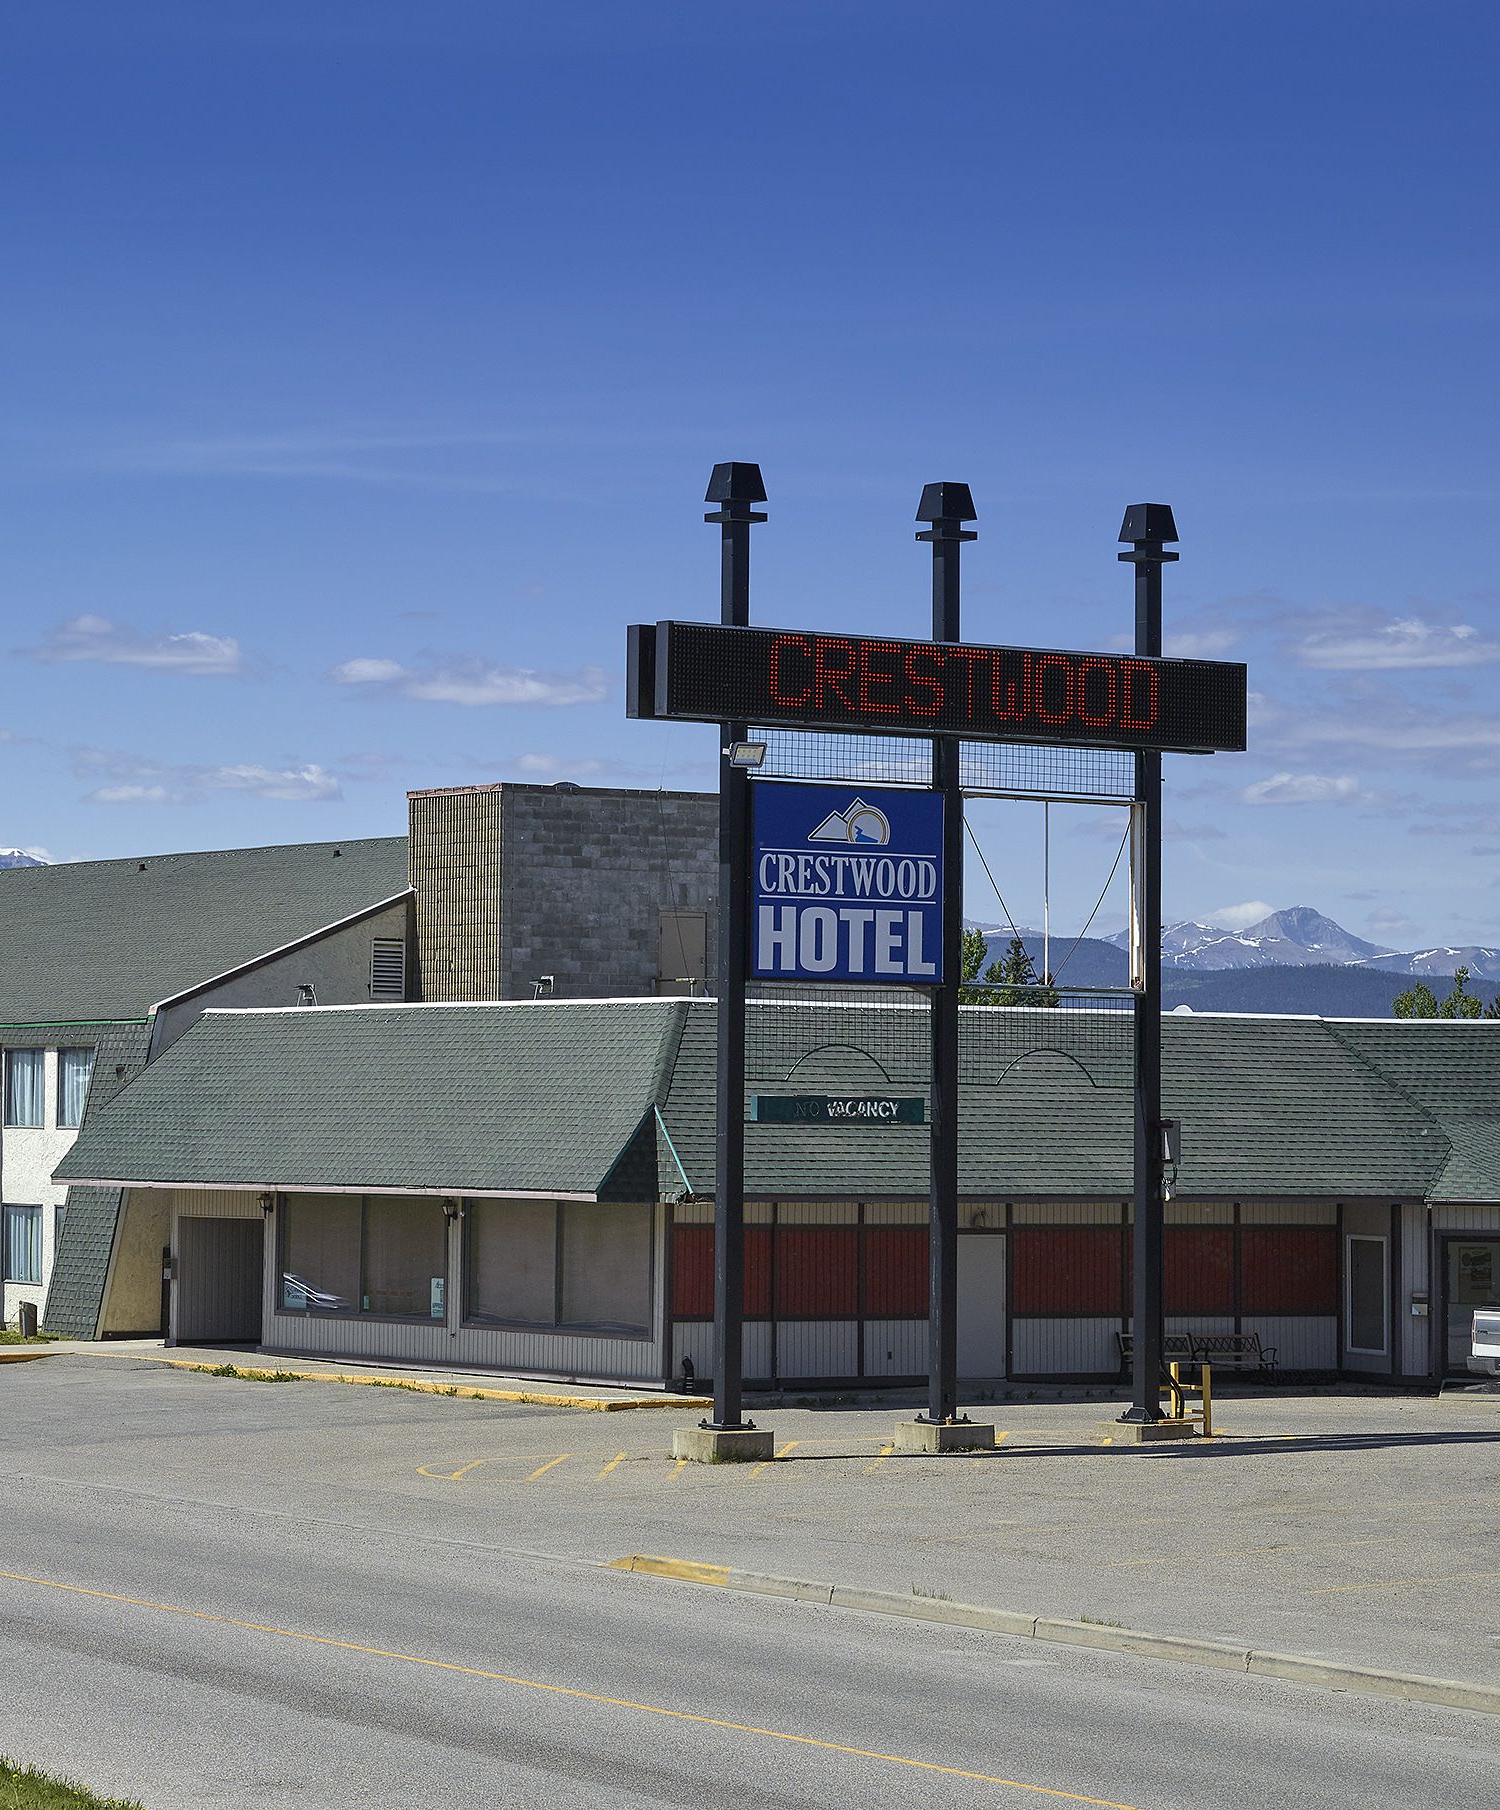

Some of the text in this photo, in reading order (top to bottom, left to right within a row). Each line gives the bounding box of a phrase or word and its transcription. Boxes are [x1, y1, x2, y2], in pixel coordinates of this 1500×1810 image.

[770, 636, 1157, 729] CRESTWOOD
[759, 853, 937, 898] CRESTWOOD
[758, 905, 936, 975] HOTEL
[796, 1101, 899, 1118] NO VACANCY
